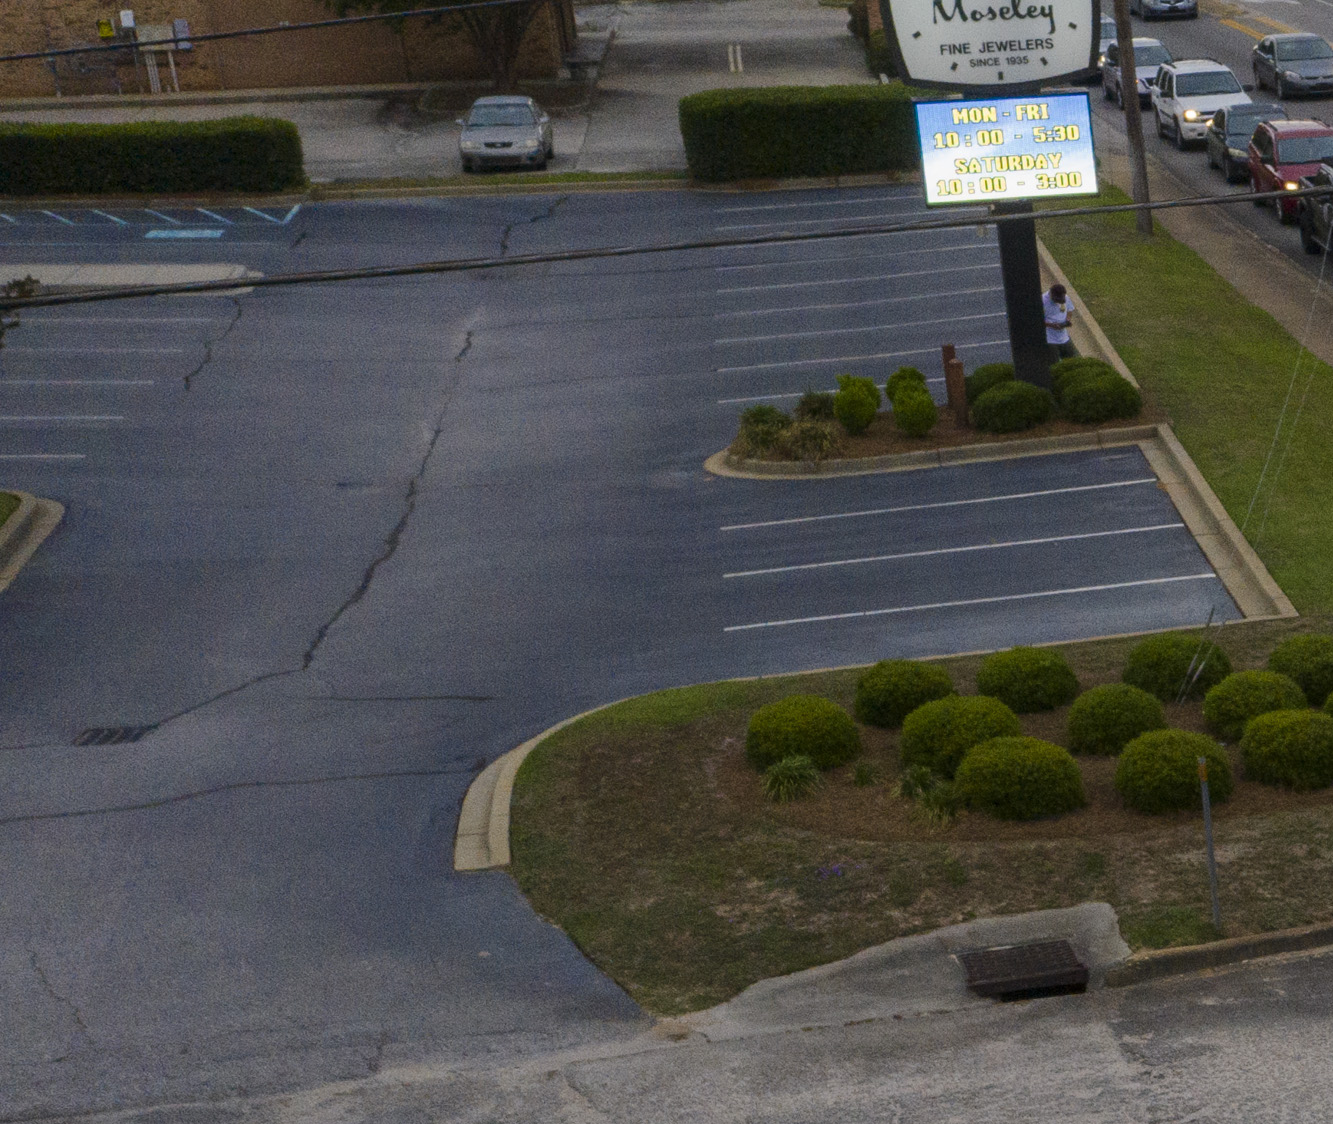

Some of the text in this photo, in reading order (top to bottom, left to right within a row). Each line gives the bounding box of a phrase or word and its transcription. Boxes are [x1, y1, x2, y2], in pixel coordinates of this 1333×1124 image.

[933, 0, 1056, 34] Moseley
[940, 38, 1054, 55] FINE JEWELERS
[969, 56, 1029, 68] SINCE 1935
[952, 106, 997, 125] MON
[1015, 103, 1049, 121] FRI
[1032, 125, 1080, 143] 5:30
[954, 152, 1063, 175] SATURDAY
[1036, 171, 1082, 190] 3:00
